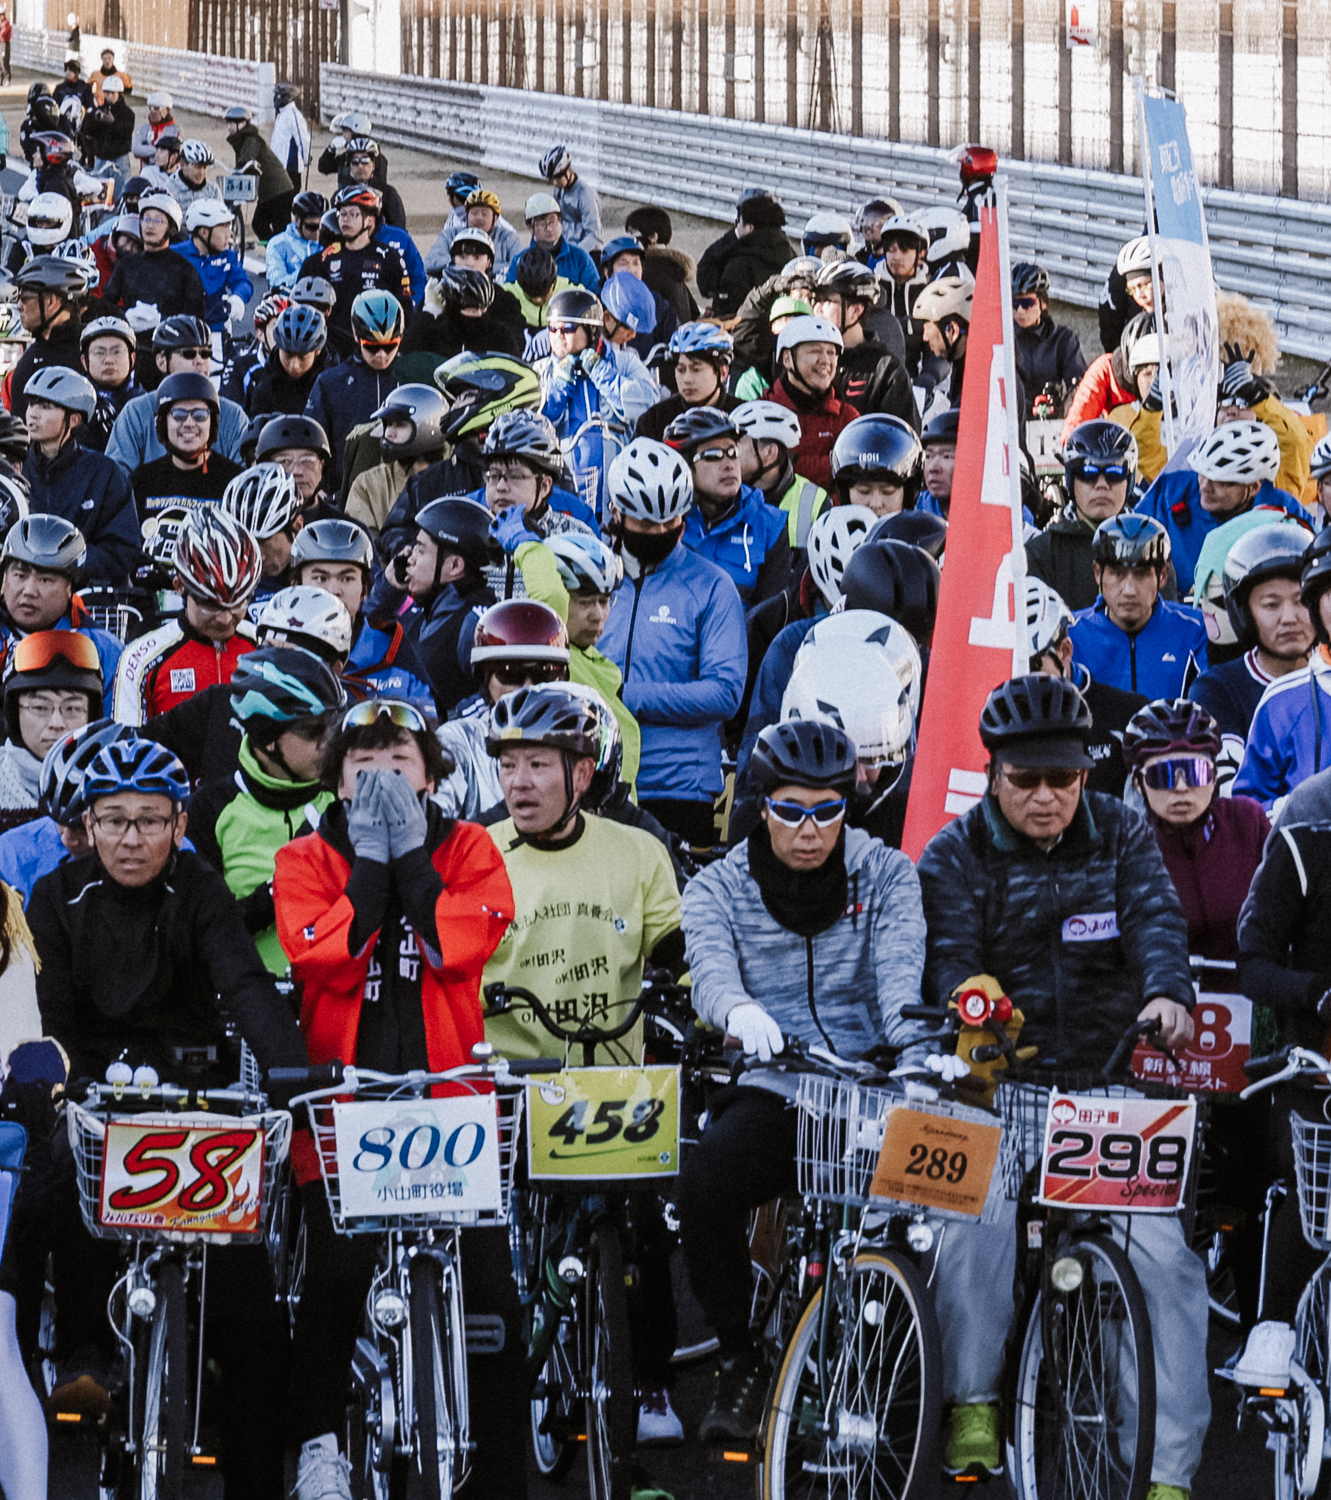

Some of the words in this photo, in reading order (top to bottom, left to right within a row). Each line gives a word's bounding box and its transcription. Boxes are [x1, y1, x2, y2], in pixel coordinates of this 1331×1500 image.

[126, 638, 157, 682] DENSO
[548, 1098, 665, 1145] 458
[353, 1122, 485, 1172] 800
[905, 1143, 968, 1184] 289
[1047, 1130, 1187, 1180] 298
[109, 1130, 257, 1212] 58
[377, 1181, 463, 1201] 小山町役場
